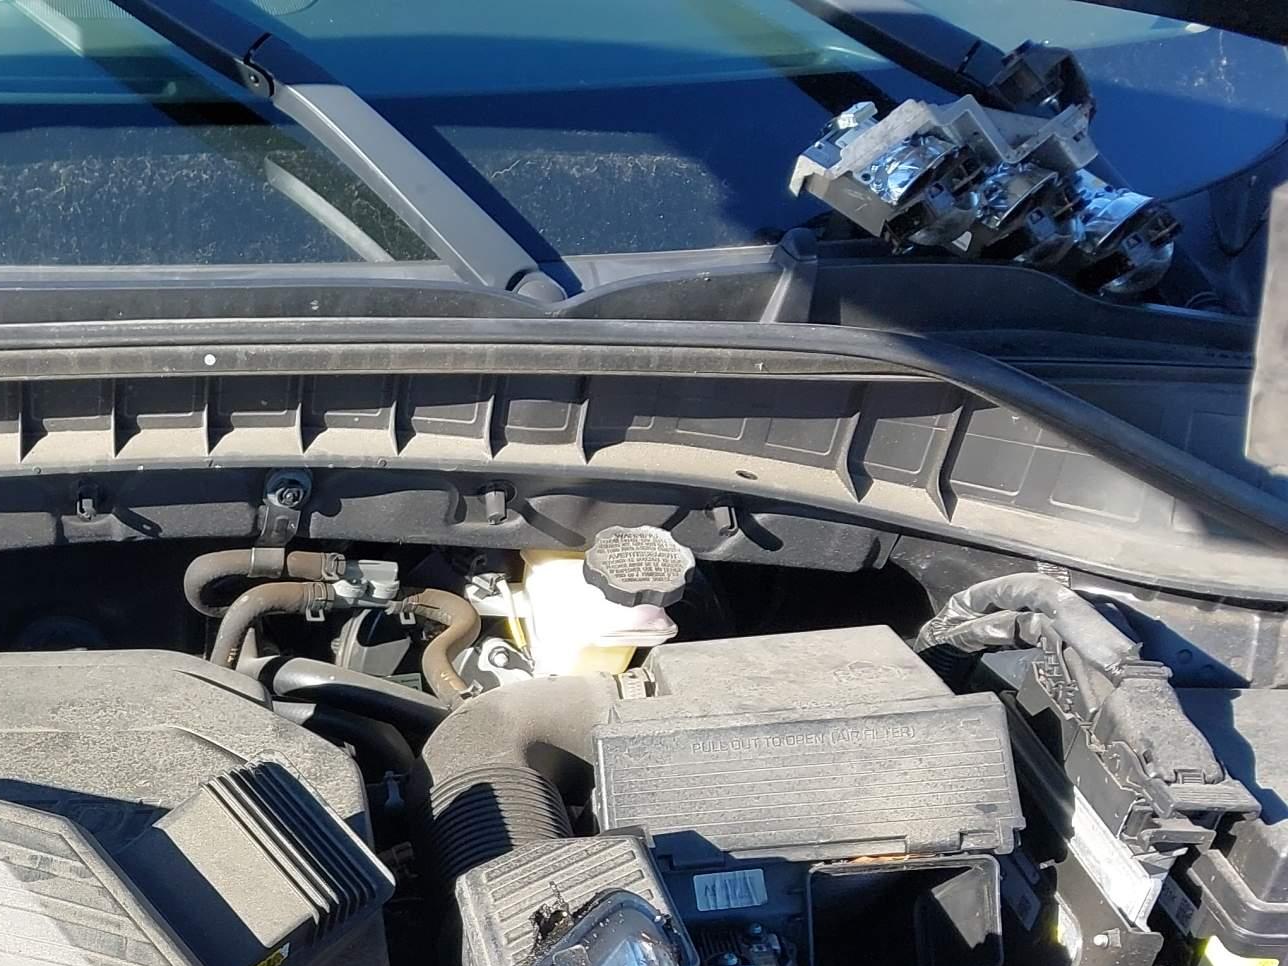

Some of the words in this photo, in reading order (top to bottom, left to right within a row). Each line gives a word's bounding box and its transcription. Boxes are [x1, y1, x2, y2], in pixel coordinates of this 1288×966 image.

[691, 741, 729, 753] PULL
[731, 737, 760, 750] OUT
[764, 736, 782, 748] TO
[785, 732, 824, 747] OPEN
